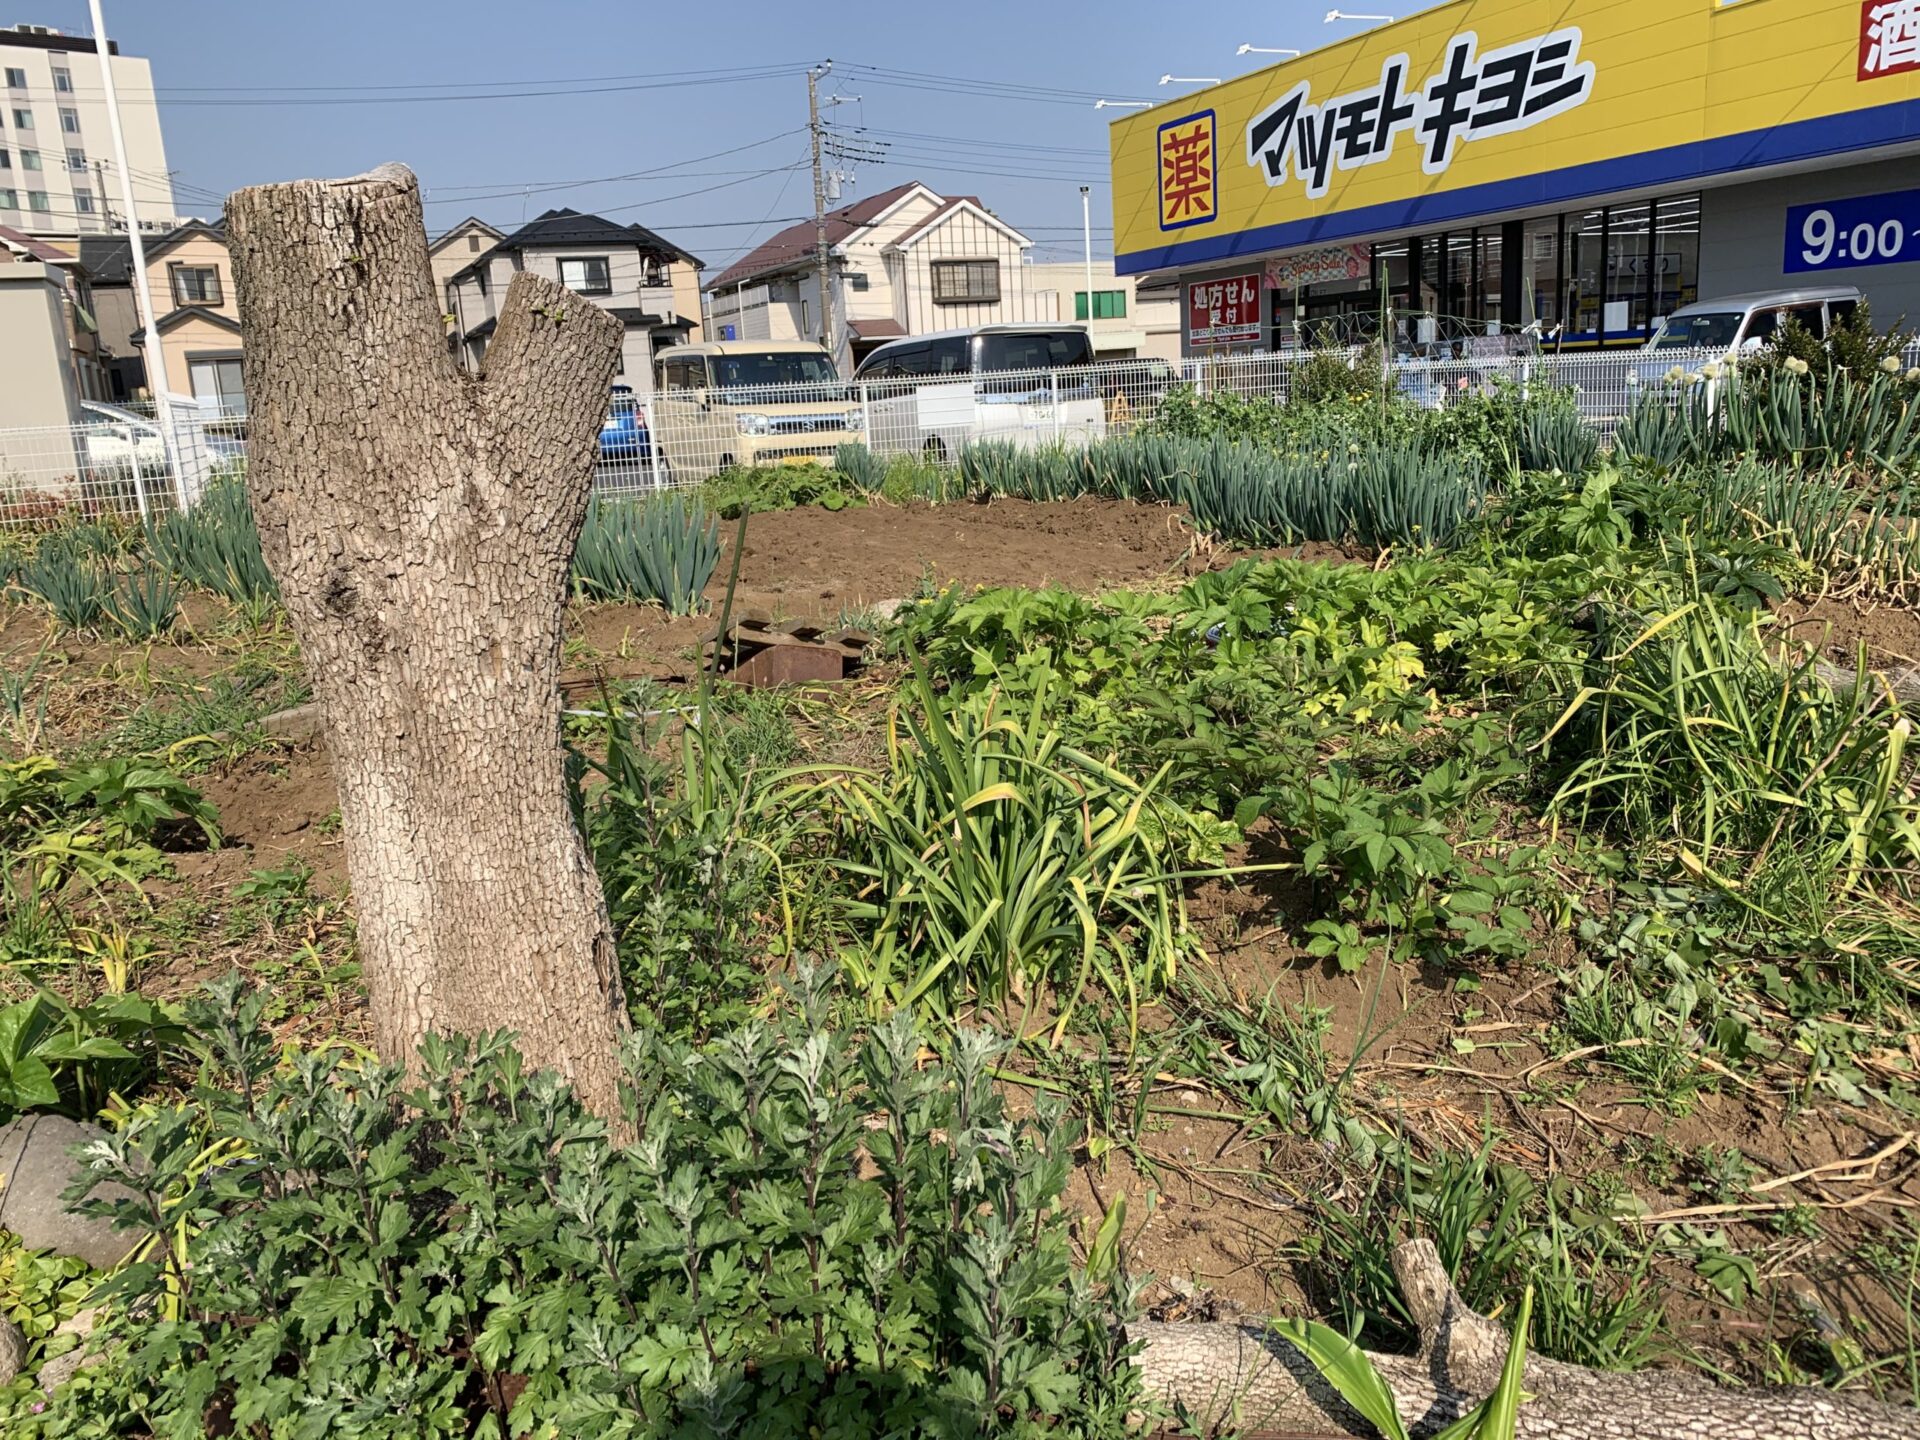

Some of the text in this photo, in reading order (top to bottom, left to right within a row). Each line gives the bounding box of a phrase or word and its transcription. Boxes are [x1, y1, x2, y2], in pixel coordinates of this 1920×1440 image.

[1864, 0, 1920, 73] 酒
[1251, 38, 1587, 190] マツモトキヨシ
[1163, 124, 1211, 220] 薬
[1801, 209, 1904, 265] 9:00
[1194, 279, 1255, 310] 処方せん
[1290, 261, 1320, 277] Spring
[1210, 306, 1237, 324] 受付
